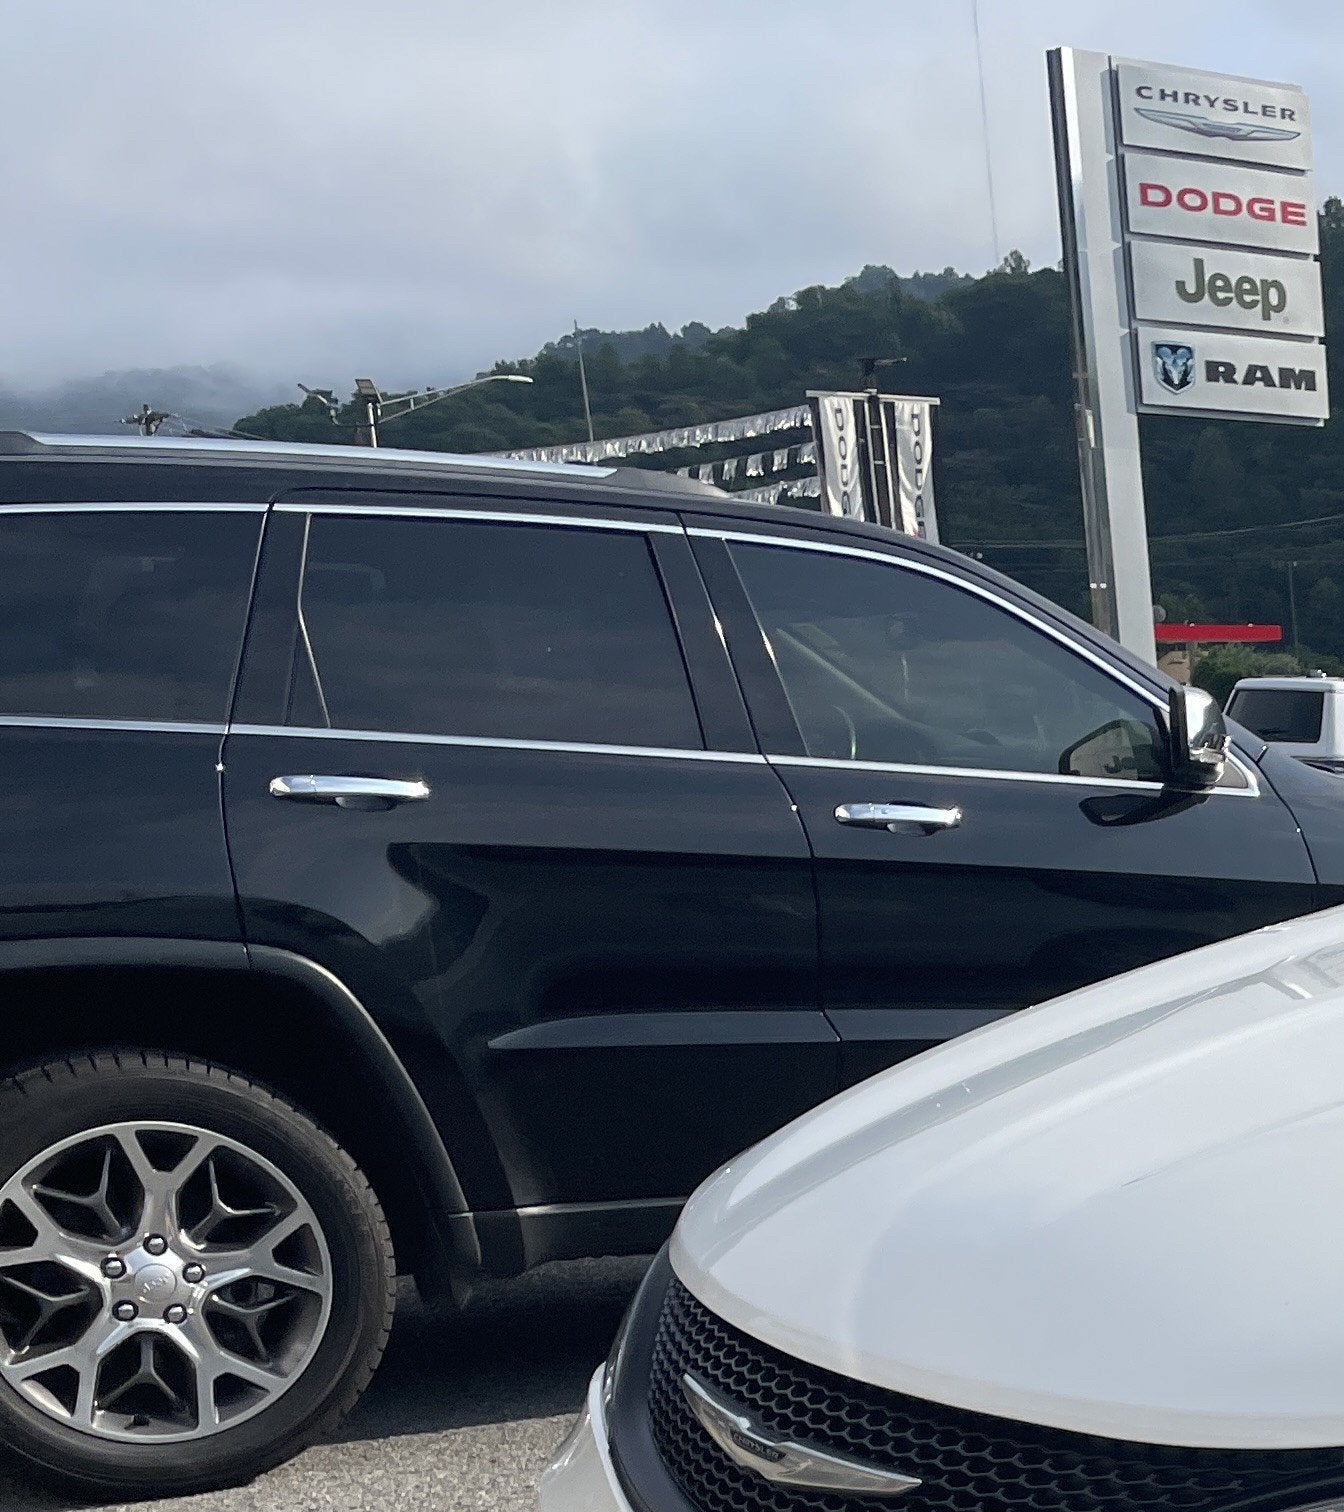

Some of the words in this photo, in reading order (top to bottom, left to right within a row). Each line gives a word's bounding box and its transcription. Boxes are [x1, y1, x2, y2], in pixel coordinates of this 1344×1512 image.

[1135, 84, 1297, 122] CHRYSLER
[1139, 182, 1308, 227] DODGE
[1175, 257, 1287, 321] Jeep
[1204, 359, 1317, 392] RAM
[834, 408, 852, 517] DODG
